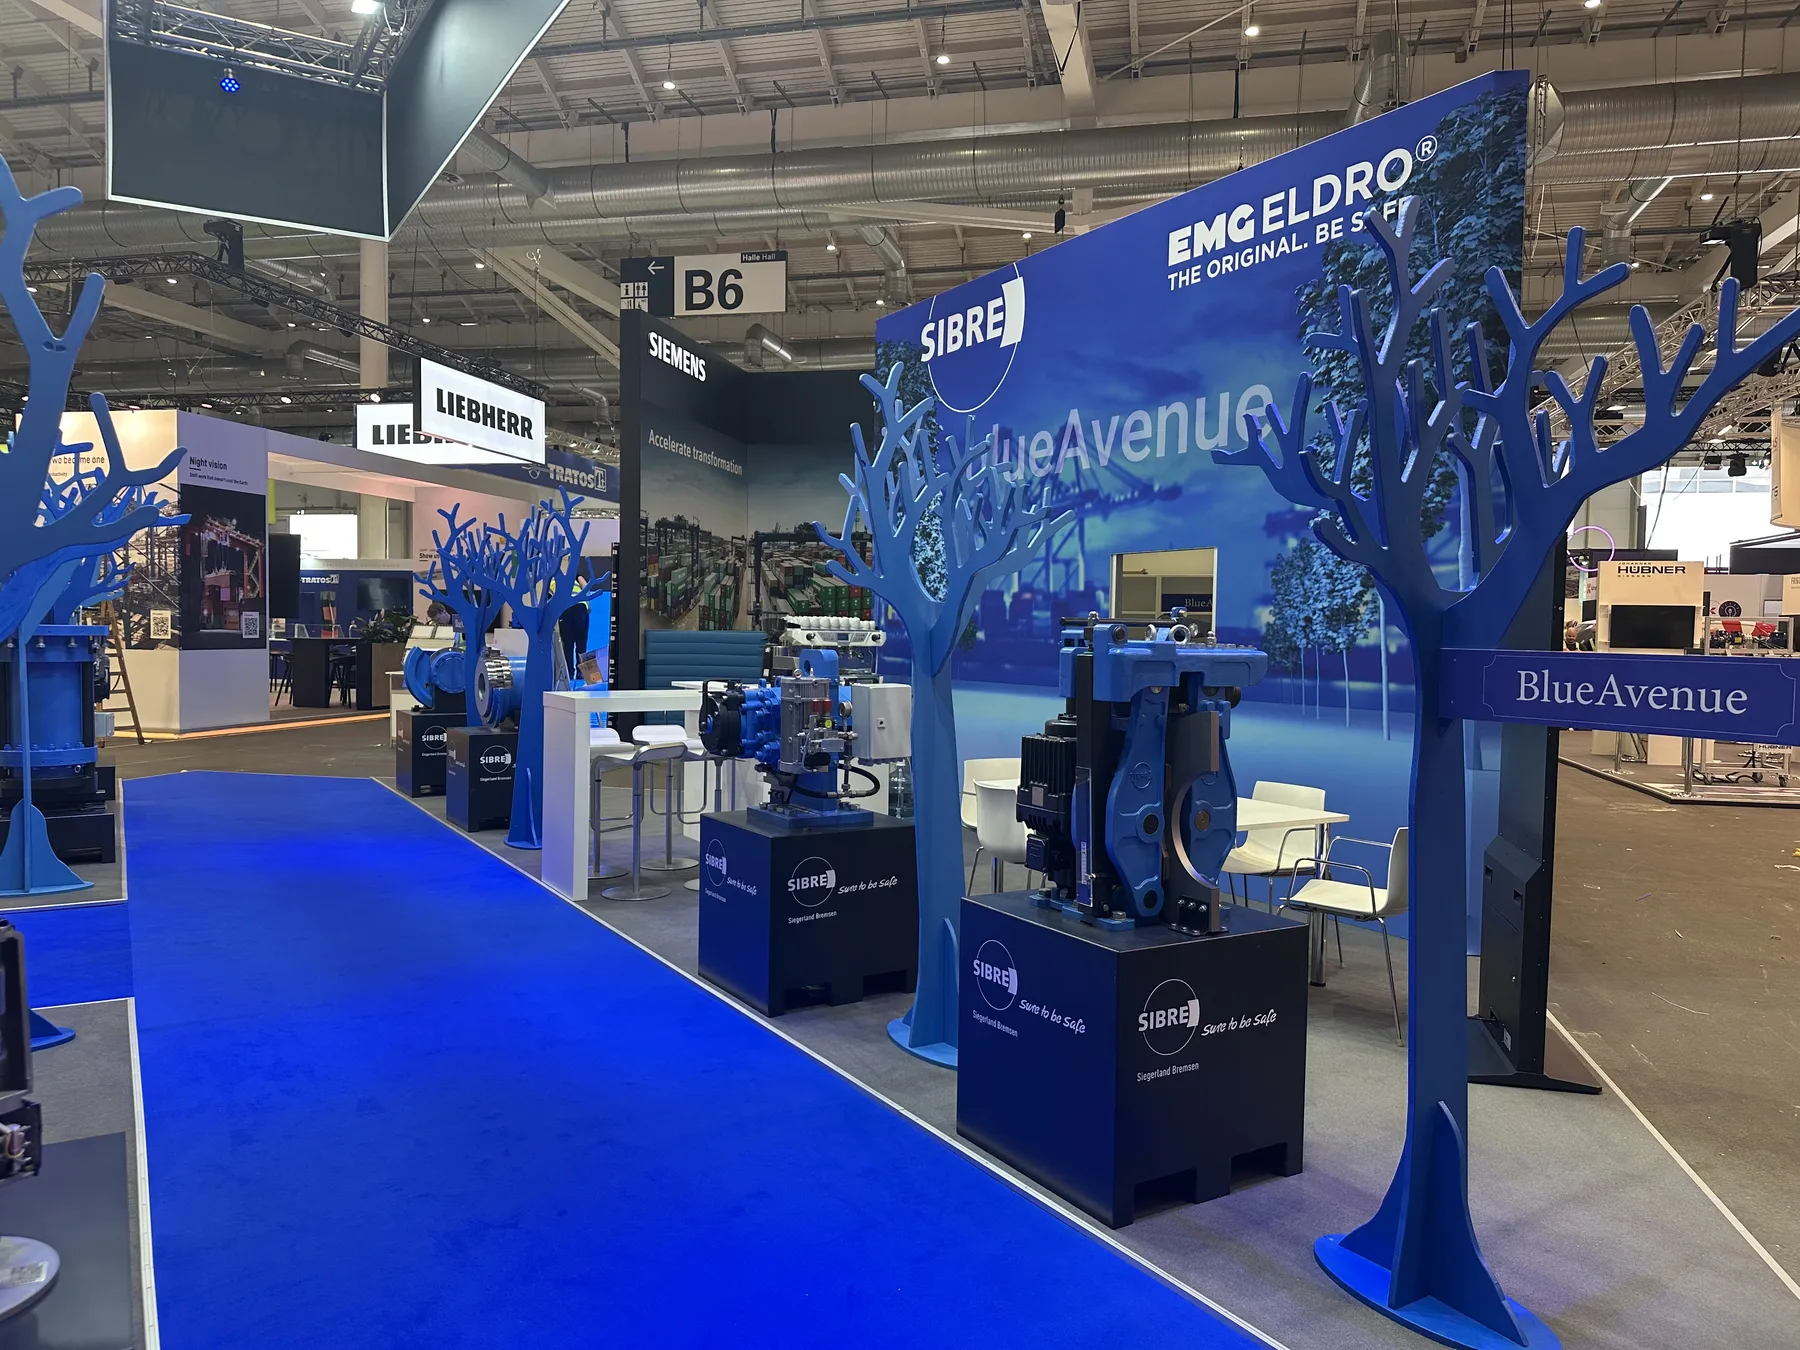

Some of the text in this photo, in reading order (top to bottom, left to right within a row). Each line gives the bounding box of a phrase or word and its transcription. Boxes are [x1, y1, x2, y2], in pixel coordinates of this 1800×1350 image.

[1168, 204, 1255, 266] EMG
[1168, 195, 1412, 291] THE ORIGINAL. BE SF
[742, 254, 760, 262] Halle
[685, 269, 744, 311] B6
[921, 296, 1004, 362] SIBRE
[649, 331, 706, 382] SIEMENS
[436, 387, 534, 440] LIEBHERR
[966, 384, 1274, 487] lueAvenue
[64, 456, 90, 464] becme
[189, 456, 228, 470] Night vision
[648, 429, 743, 476] Accelerate transformation
[547, 463, 595, 488] TRATOS
[1617, 566, 1686, 574] HÜBNER
[1516, 669, 1748, 715] BlueAvenue
[421, 734, 444, 742] SIBRE
[480, 755, 506, 764] SIBRE
[705, 853, 723, 871] SIBRE
[787, 873, 827, 892] SIBRE
[837, 884, 858, 895] Sure
[858, 881, 866, 891] to
[867, 880, 877, 889] be
[788, 910, 838, 924] Siegerland Bremsen
[973, 959, 1010, 988] SIBRE
[972, 1009, 1019, 1038] Siegerland Bremsen
[1018, 999, 1040, 1015] Sure
[1040, 1005, 1050, 1018] to
[1050, 1009, 1062, 1024] be
[1138, 1005, 1189, 1032] SIBRE
[1201, 1022, 1226, 1037] Sure
[1227, 1016, 1238, 1031] to
[1239, 1014, 1252, 1029] be
[1136, 1062, 1200, 1082] Siegerland Bremsen
